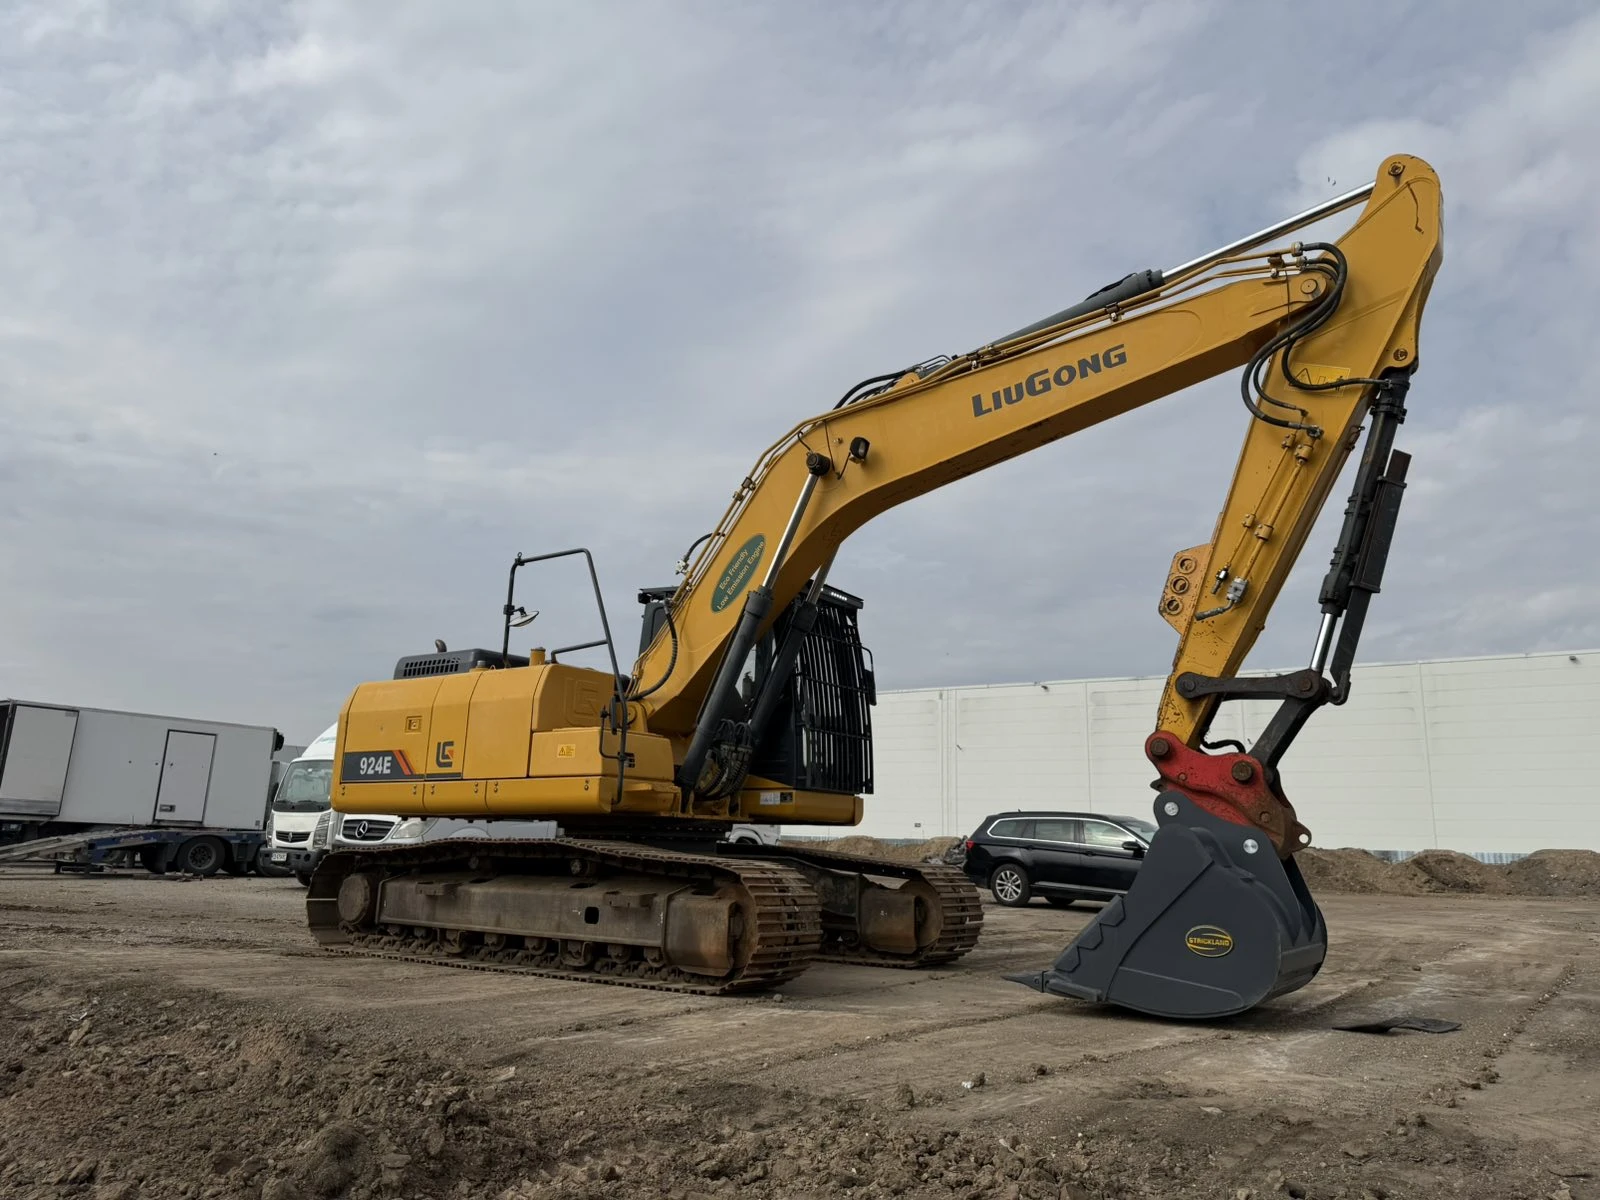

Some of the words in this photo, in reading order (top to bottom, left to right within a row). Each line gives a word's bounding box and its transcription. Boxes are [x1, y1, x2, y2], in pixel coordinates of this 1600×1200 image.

[717, 595, 729, 610] Low
[727, 565, 749, 595] Emission
[747, 541, 764, 565] Engine
[719, 576, 730, 590] Eco
[728, 549, 749, 576] Friendly
[360, 756, 392, 775] 924E
[1188, 937, 1230, 946] STRICKLAND
